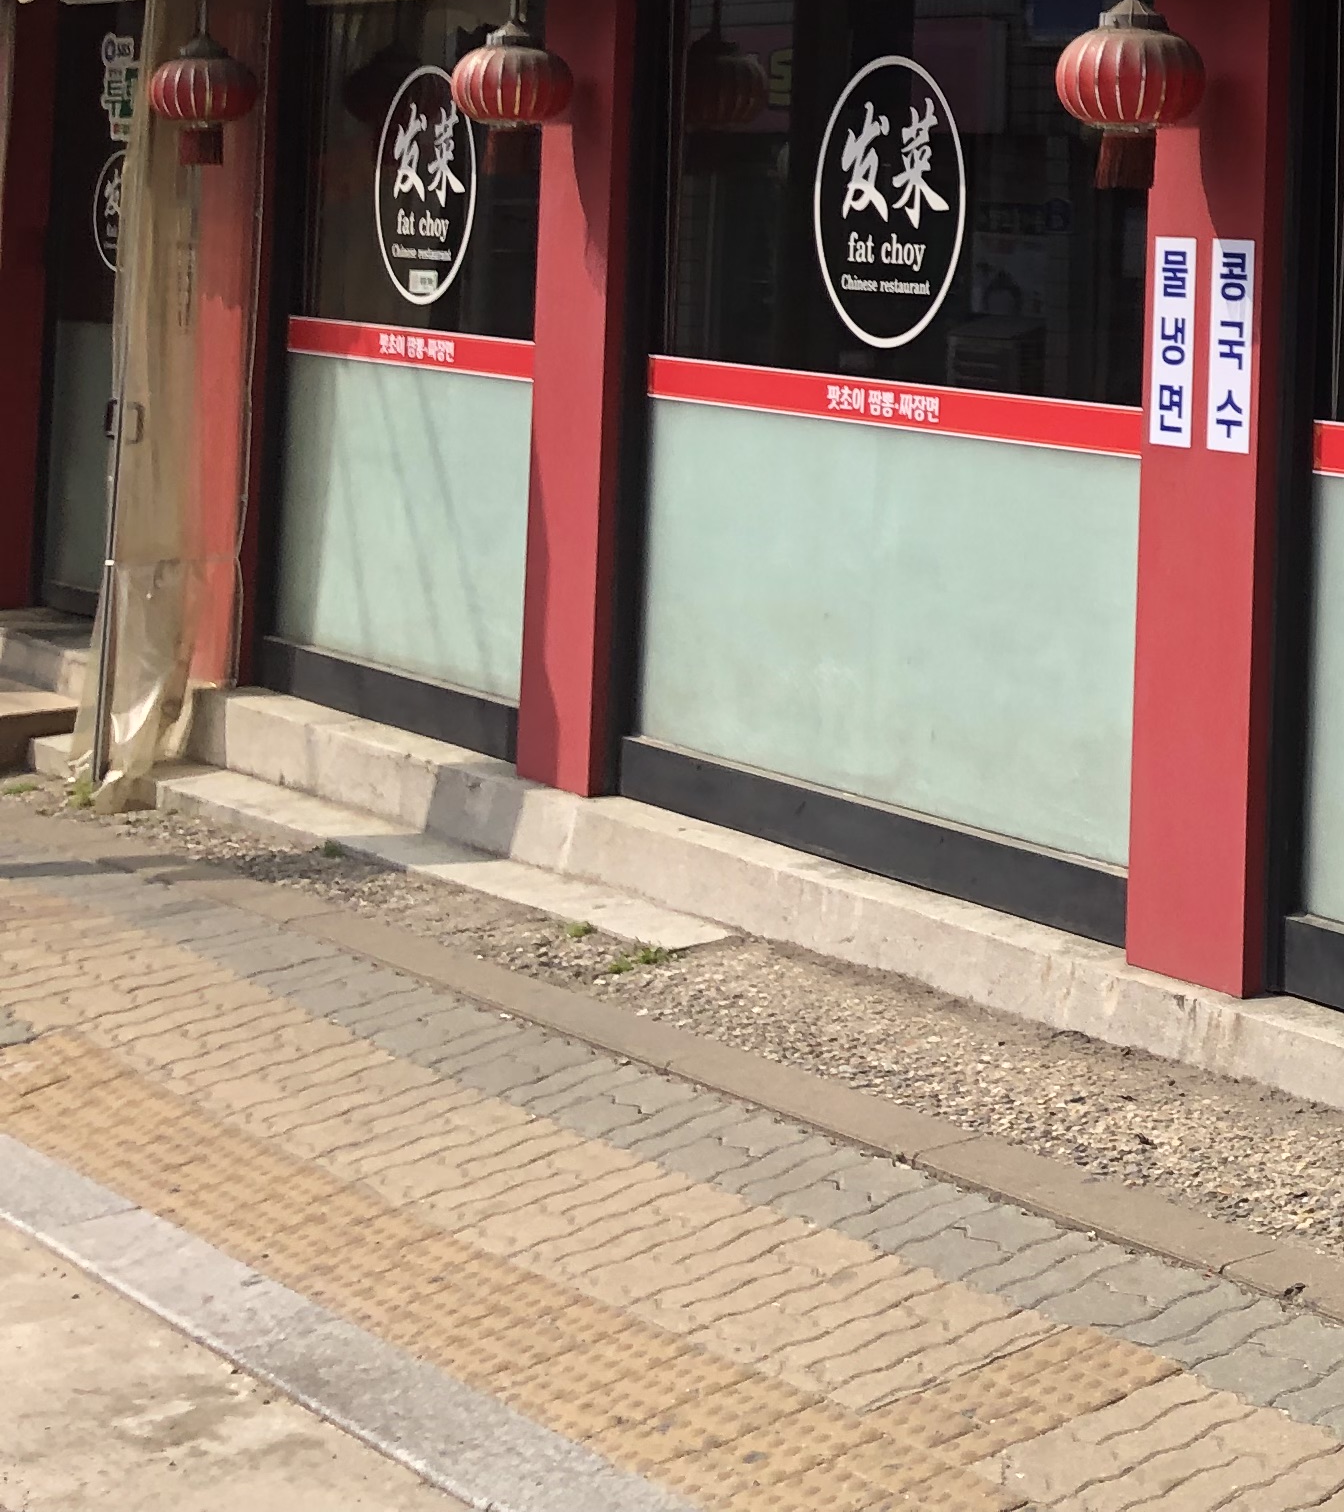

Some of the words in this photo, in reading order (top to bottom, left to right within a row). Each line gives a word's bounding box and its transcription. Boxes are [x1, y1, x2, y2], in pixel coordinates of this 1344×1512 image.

[397, 208, 416, 236] fat
[419, 209, 450, 242] choy
[847, 231, 875, 264] fat
[881, 233, 926, 272] choy
[841, 274, 878, 292] Chinese
[879, 278, 930, 296] restaurant
[379, 332, 405, 358] 팟초이
[1159, 250, 1188, 433] 물냉면
[1216, 252, 1248, 439] 콩국수
[826, 384, 865, 413] 팟초이
